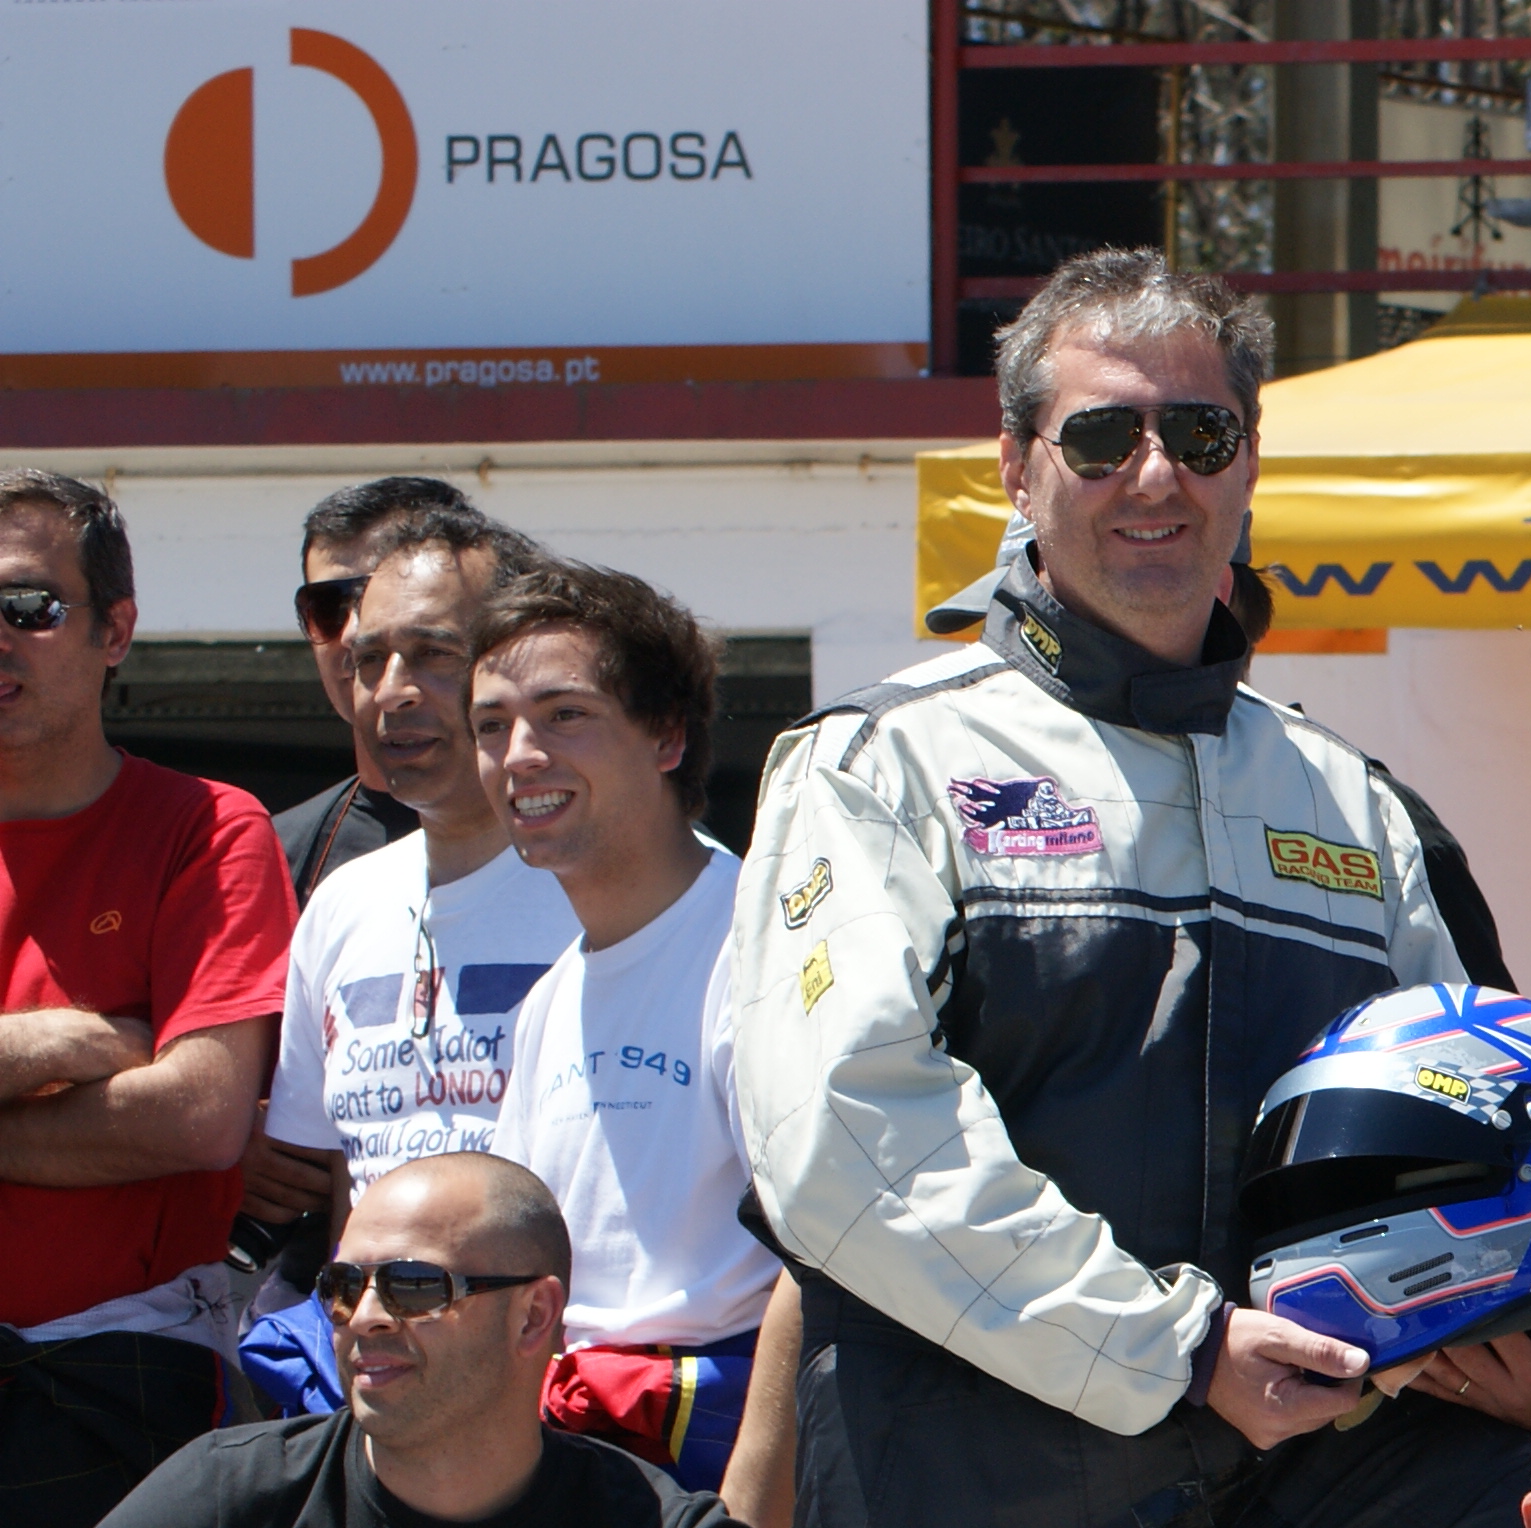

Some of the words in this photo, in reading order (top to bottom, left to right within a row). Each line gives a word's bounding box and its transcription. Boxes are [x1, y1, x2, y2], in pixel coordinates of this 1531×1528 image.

[445, 131, 753, 184] PRAGOSA
[340, 355, 600, 387] www.pragosa.pt
[1271, 838, 1377, 880] GAS
[1277, 864, 1331, 885] RACING
[1334, 877, 1379, 894] TEAM
[341, 1036, 414, 1076] Some
[434, 1024, 506, 1065] Idiot
[375, 1082, 404, 1115] to
[414, 1067, 513, 1108] LONDO
[1417, 1067, 1471, 1099] OMP
[365, 1123, 390, 1154] all
[406, 1118, 455, 1161] got
